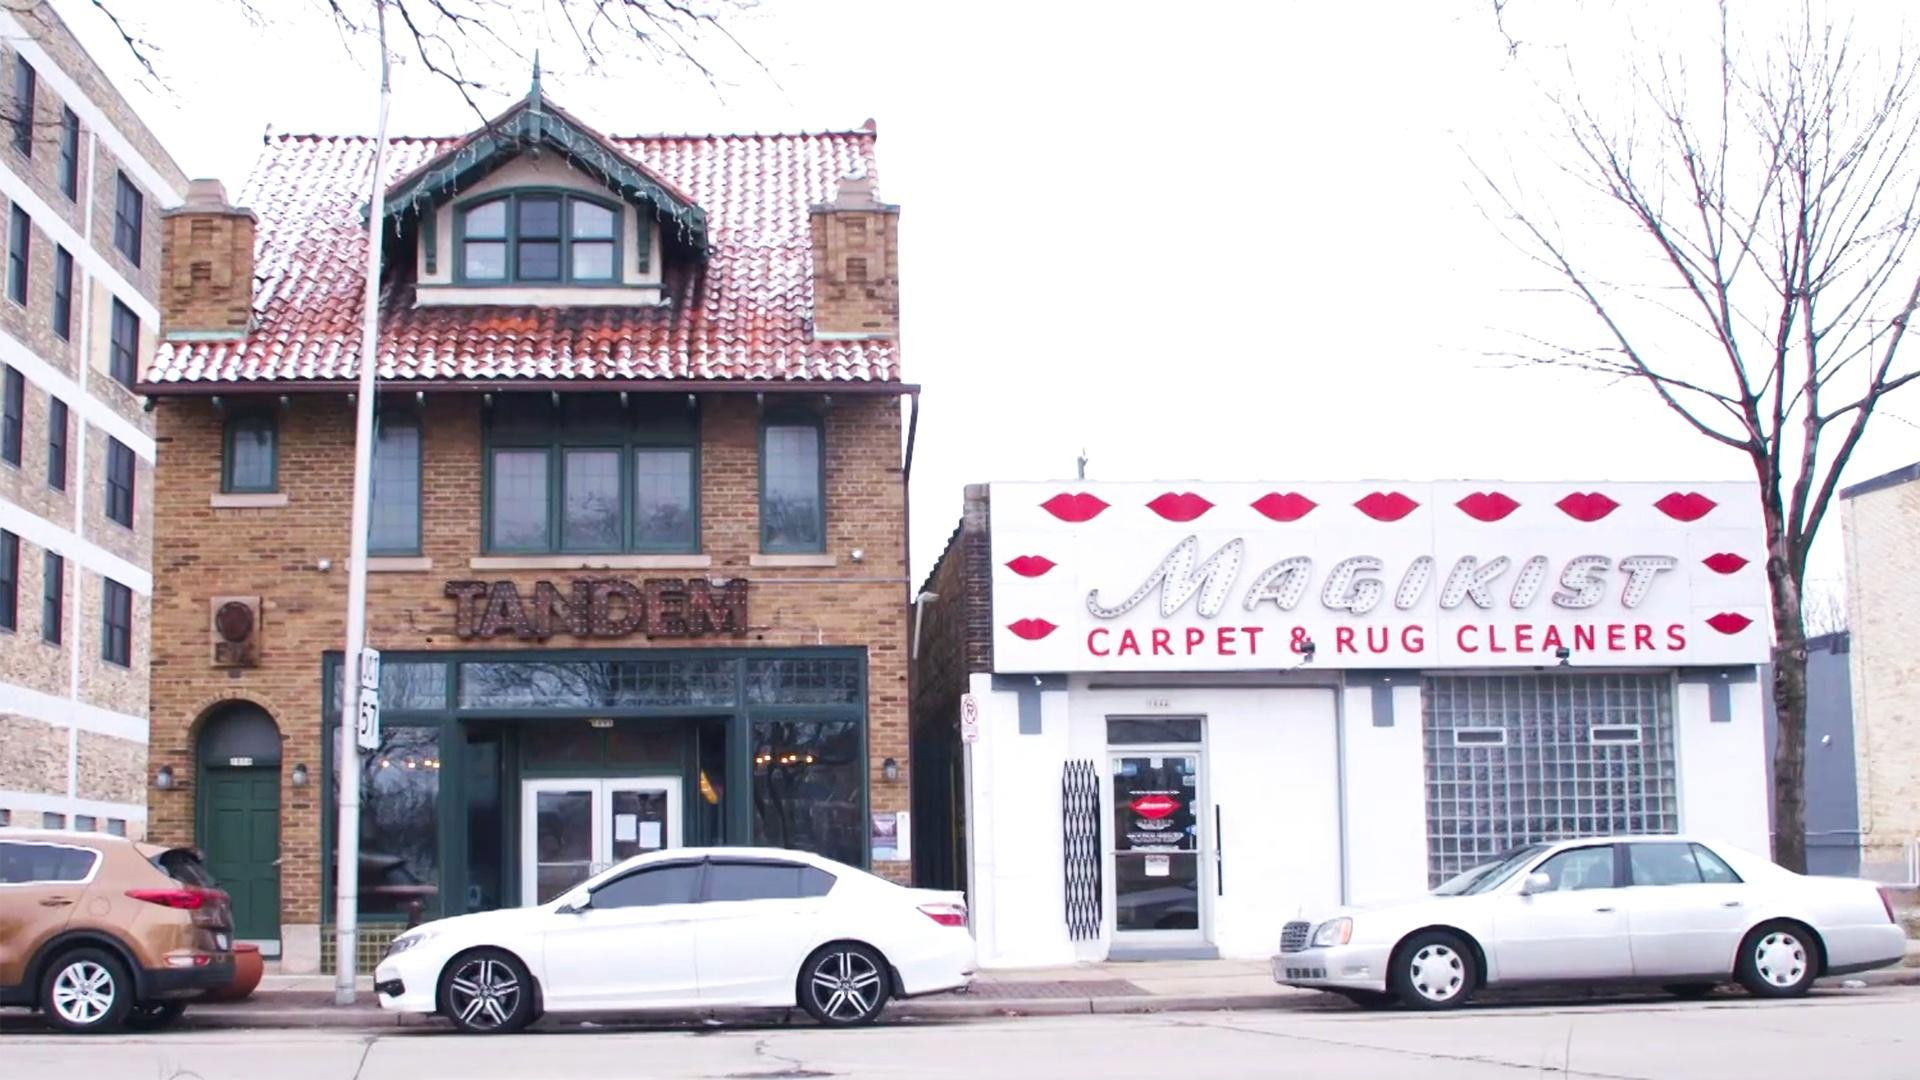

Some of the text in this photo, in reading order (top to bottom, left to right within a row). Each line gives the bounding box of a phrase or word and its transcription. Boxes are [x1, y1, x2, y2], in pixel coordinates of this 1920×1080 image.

[1087, 535, 1678, 619] MAGIKIST
[445, 578, 749, 640] TANDEM
[1088, 623, 1686, 656] CARPET & RUG CLEANERS
[361, 701, 376, 736] 57
